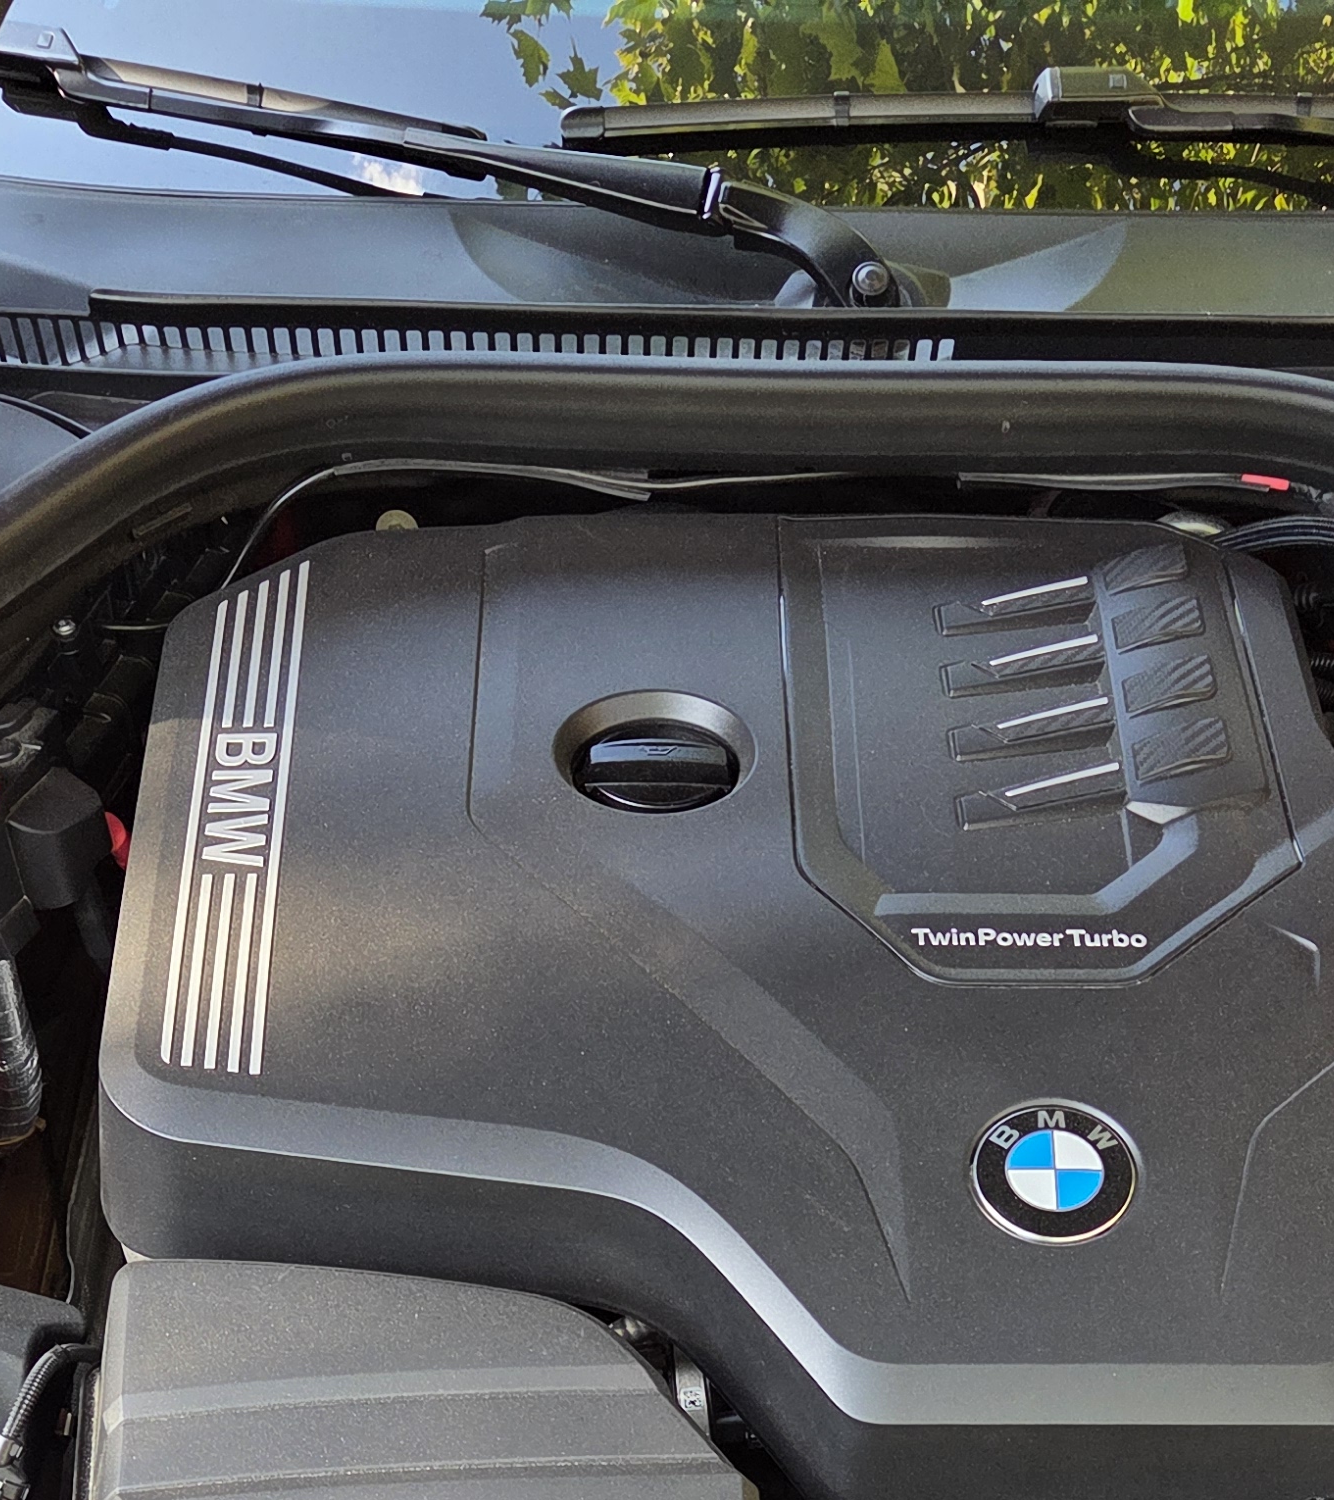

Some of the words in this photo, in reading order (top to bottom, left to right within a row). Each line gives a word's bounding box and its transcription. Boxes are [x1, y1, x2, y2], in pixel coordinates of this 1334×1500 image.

[202, 732, 278, 868] BMW
[1065, 928, 1148, 948] Turbo
[988, 1110, 1119, 1150] BMW
